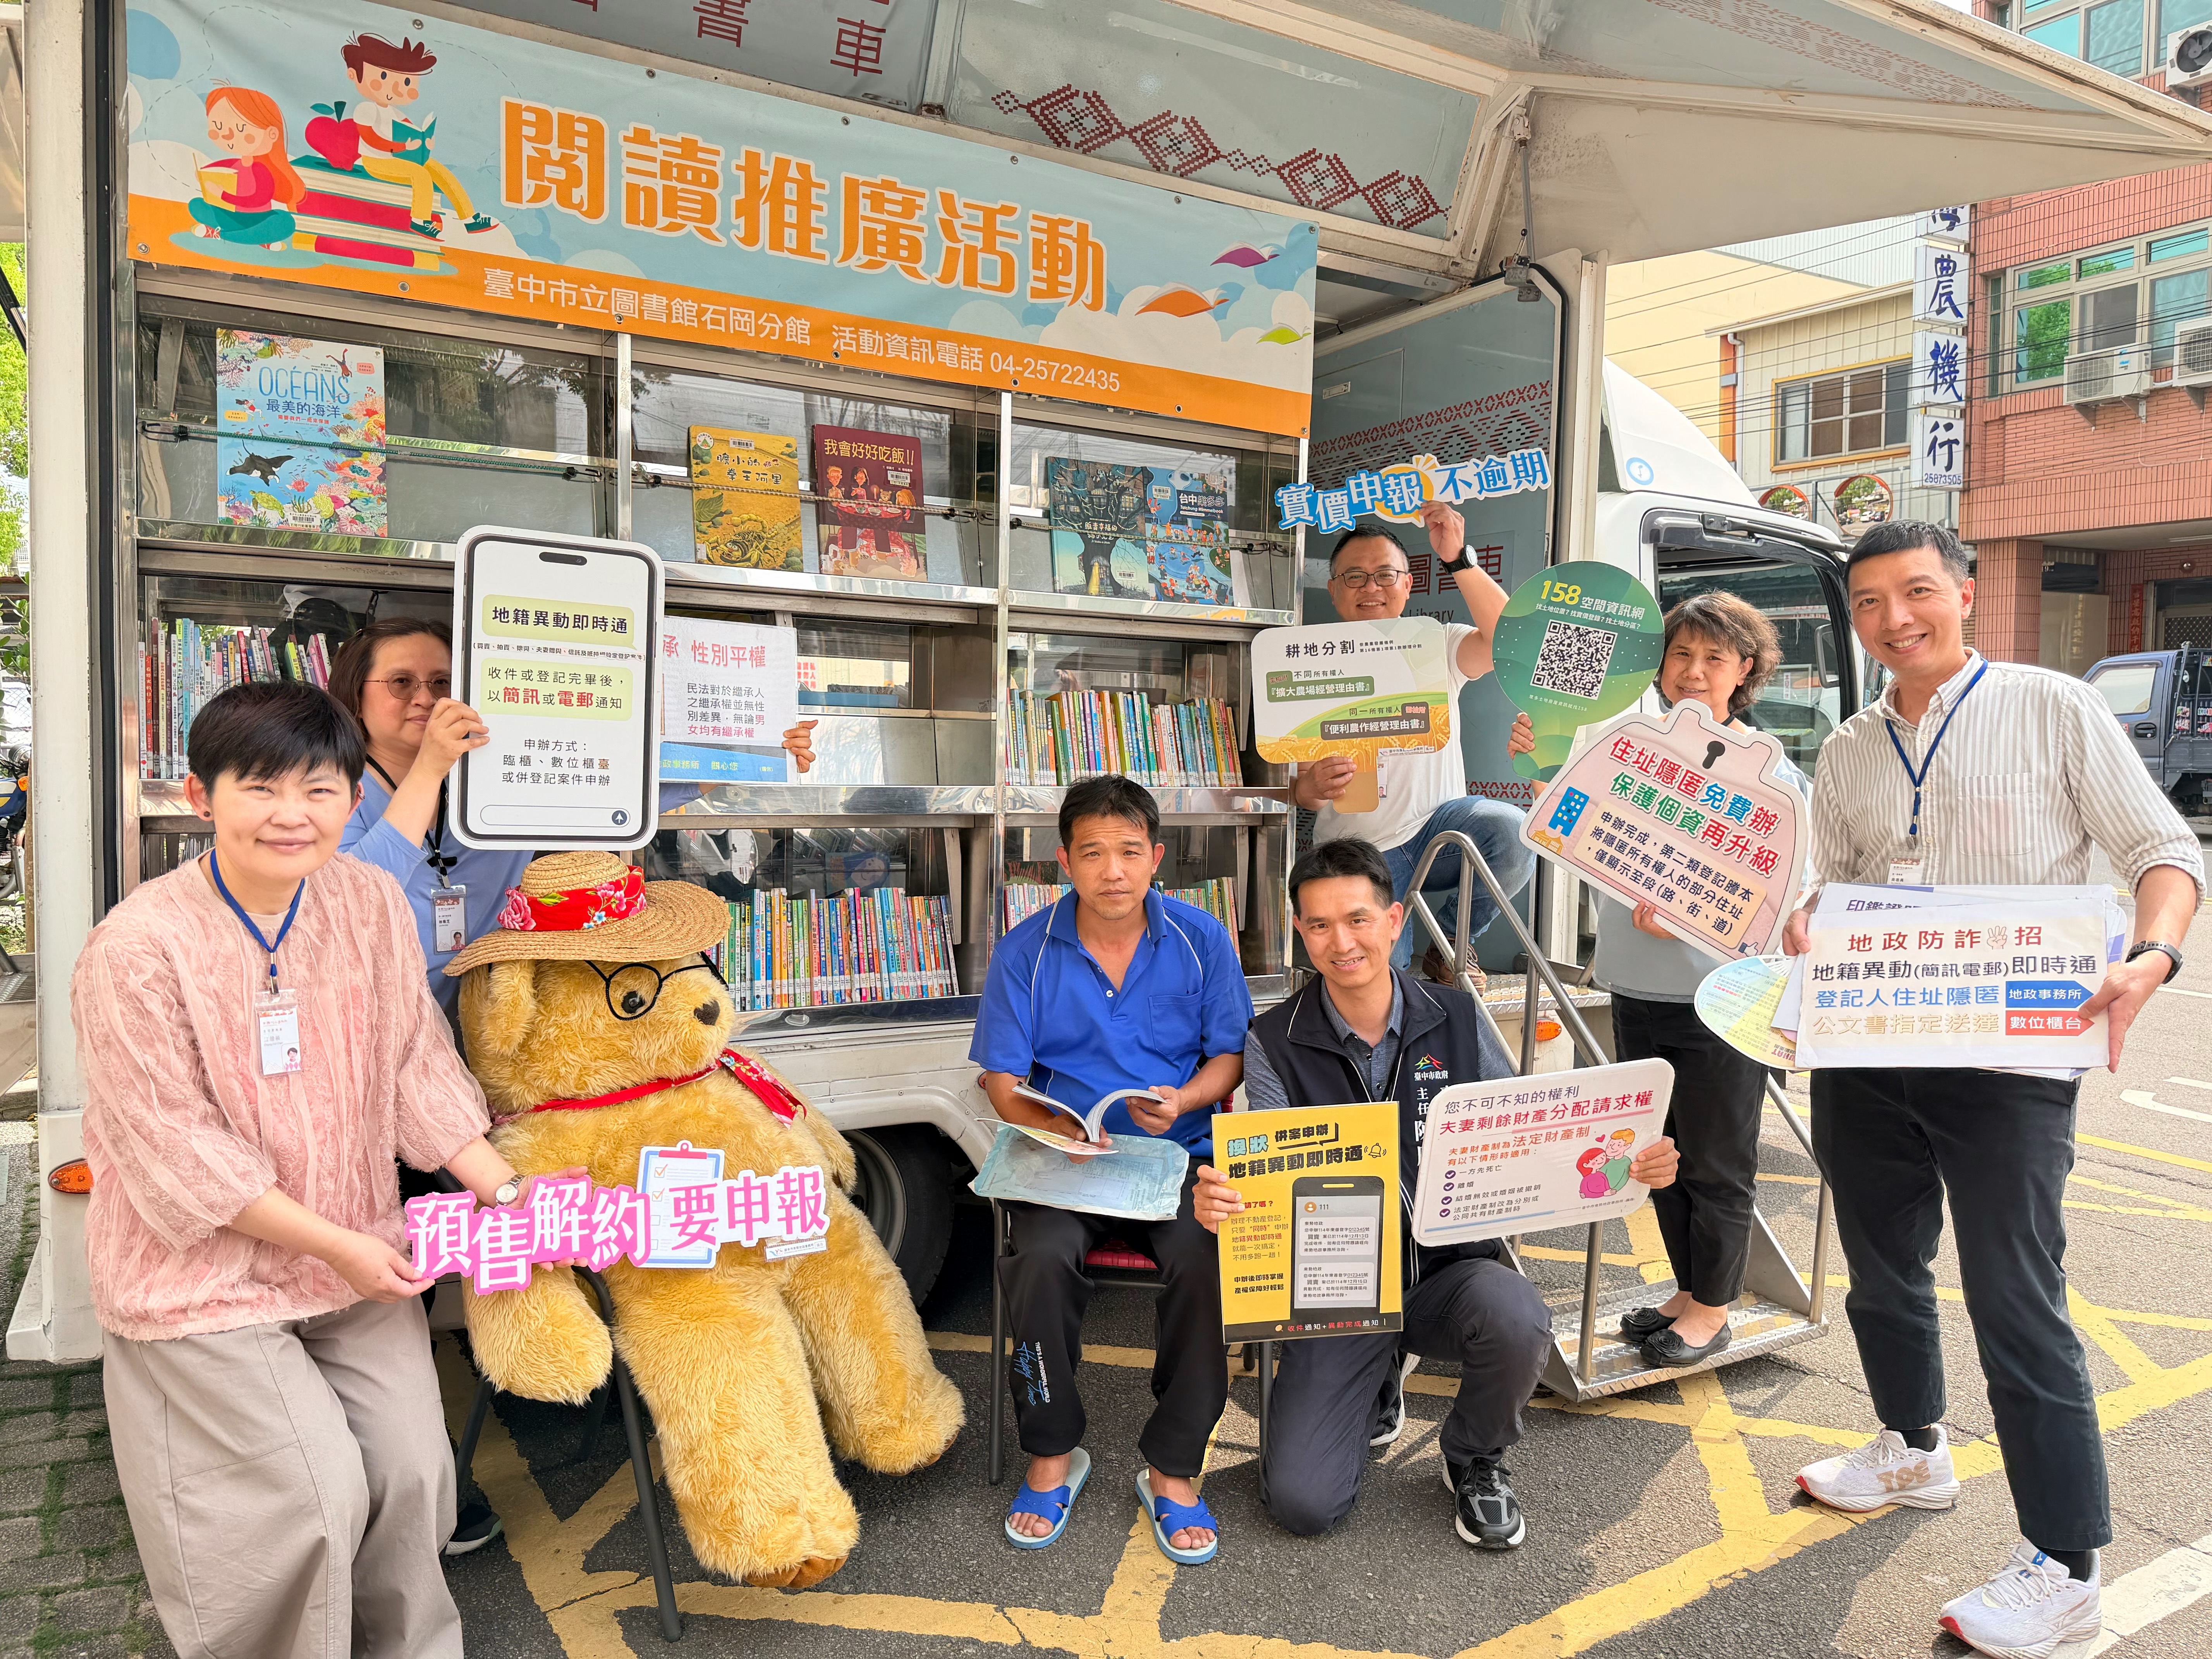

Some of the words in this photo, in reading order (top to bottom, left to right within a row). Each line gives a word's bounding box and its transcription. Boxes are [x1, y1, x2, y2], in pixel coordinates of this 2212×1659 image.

[504, 101, 1107, 310] 閱讀推廣活動
[484, 267, 811, 346] 臺中市立圖書館石岡分館
[832, 324, 983, 373] 活動資訊電話
[990, 352, 1121, 393] 04-25722435
[259, 366, 350, 404] OCÉANS
[266, 399, 342, 418] 最美的海洋
[1277, 472, 1425, 531] 實價申報
[1434, 449, 1549, 501] 不逾期
[1541, 580, 1582, 605] 158
[1579, 597, 1645, 621] 空間資訊網
[492, 606, 628, 635] 地籍異動即時通
[691, 639, 766, 669] 性別平權
[1285, 639, 1355, 659] 耕地分割
[1294, 669, 1345, 679] 不同所有權人
[488, 687, 622, 710] 以簡訊或電郵通知
[687, 683, 765, 698] 民法對於繼承人
[687, 697, 765, 712] 之繼承權並無性
[1349, 706, 1401, 717] 同一所有權人
[687, 724, 755, 738] 女均有繼承權
[659, 759, 699, 769] 政事務所
[502, 772, 610, 787] 或併登記案件申辦
[1609, 734, 1781, 838] 住址隱匿免費辦
[1609, 771, 1781, 878] 保護個資再升級
[1590, 826, 1743, 920] 將隱匿所有權人的部分住址
[1847, 928, 1982, 953] 地政防詐
[2014, 925, 2042, 947] 招
[1815, 986, 2000, 1009] 登記人住址隱匿
[2009, 988, 2082, 1002] 地政事務所
[1812, 1012, 1999, 1037] 公文書指定送達
[2009, 1015, 2083, 1031] 數位櫃台
[1414, 1070, 1449, 1081] 臺中市政府
[1445, 1085, 1580, 1115] 您不可不知的權利
[1439, 1090, 1654, 1135] 夫妻剩餘財產分配請求權
[1274, 1123, 1329, 1143] 併案申辦
[1448, 1125, 1591, 1157] 夫妻財產制為法定財產制
[1228, 1144, 1363, 1179] 地籍異動即時通
[1459, 1164, 1503, 1175] 一方先死亡
[1457, 1181, 1474, 1189] 離婚
[1454, 1195, 1539, 1213] 法定財產制改為分別或
[409, 1181, 646, 1289] 預售解約
[669, 1170, 827, 1250] 要申報
[1232, 1233, 1282, 1243] 地籍異動即時通
[1234, 1273, 1284, 1283] 申辦後即時掌握
[1234, 1283, 1284, 1294] 產權保障好輕鬆
